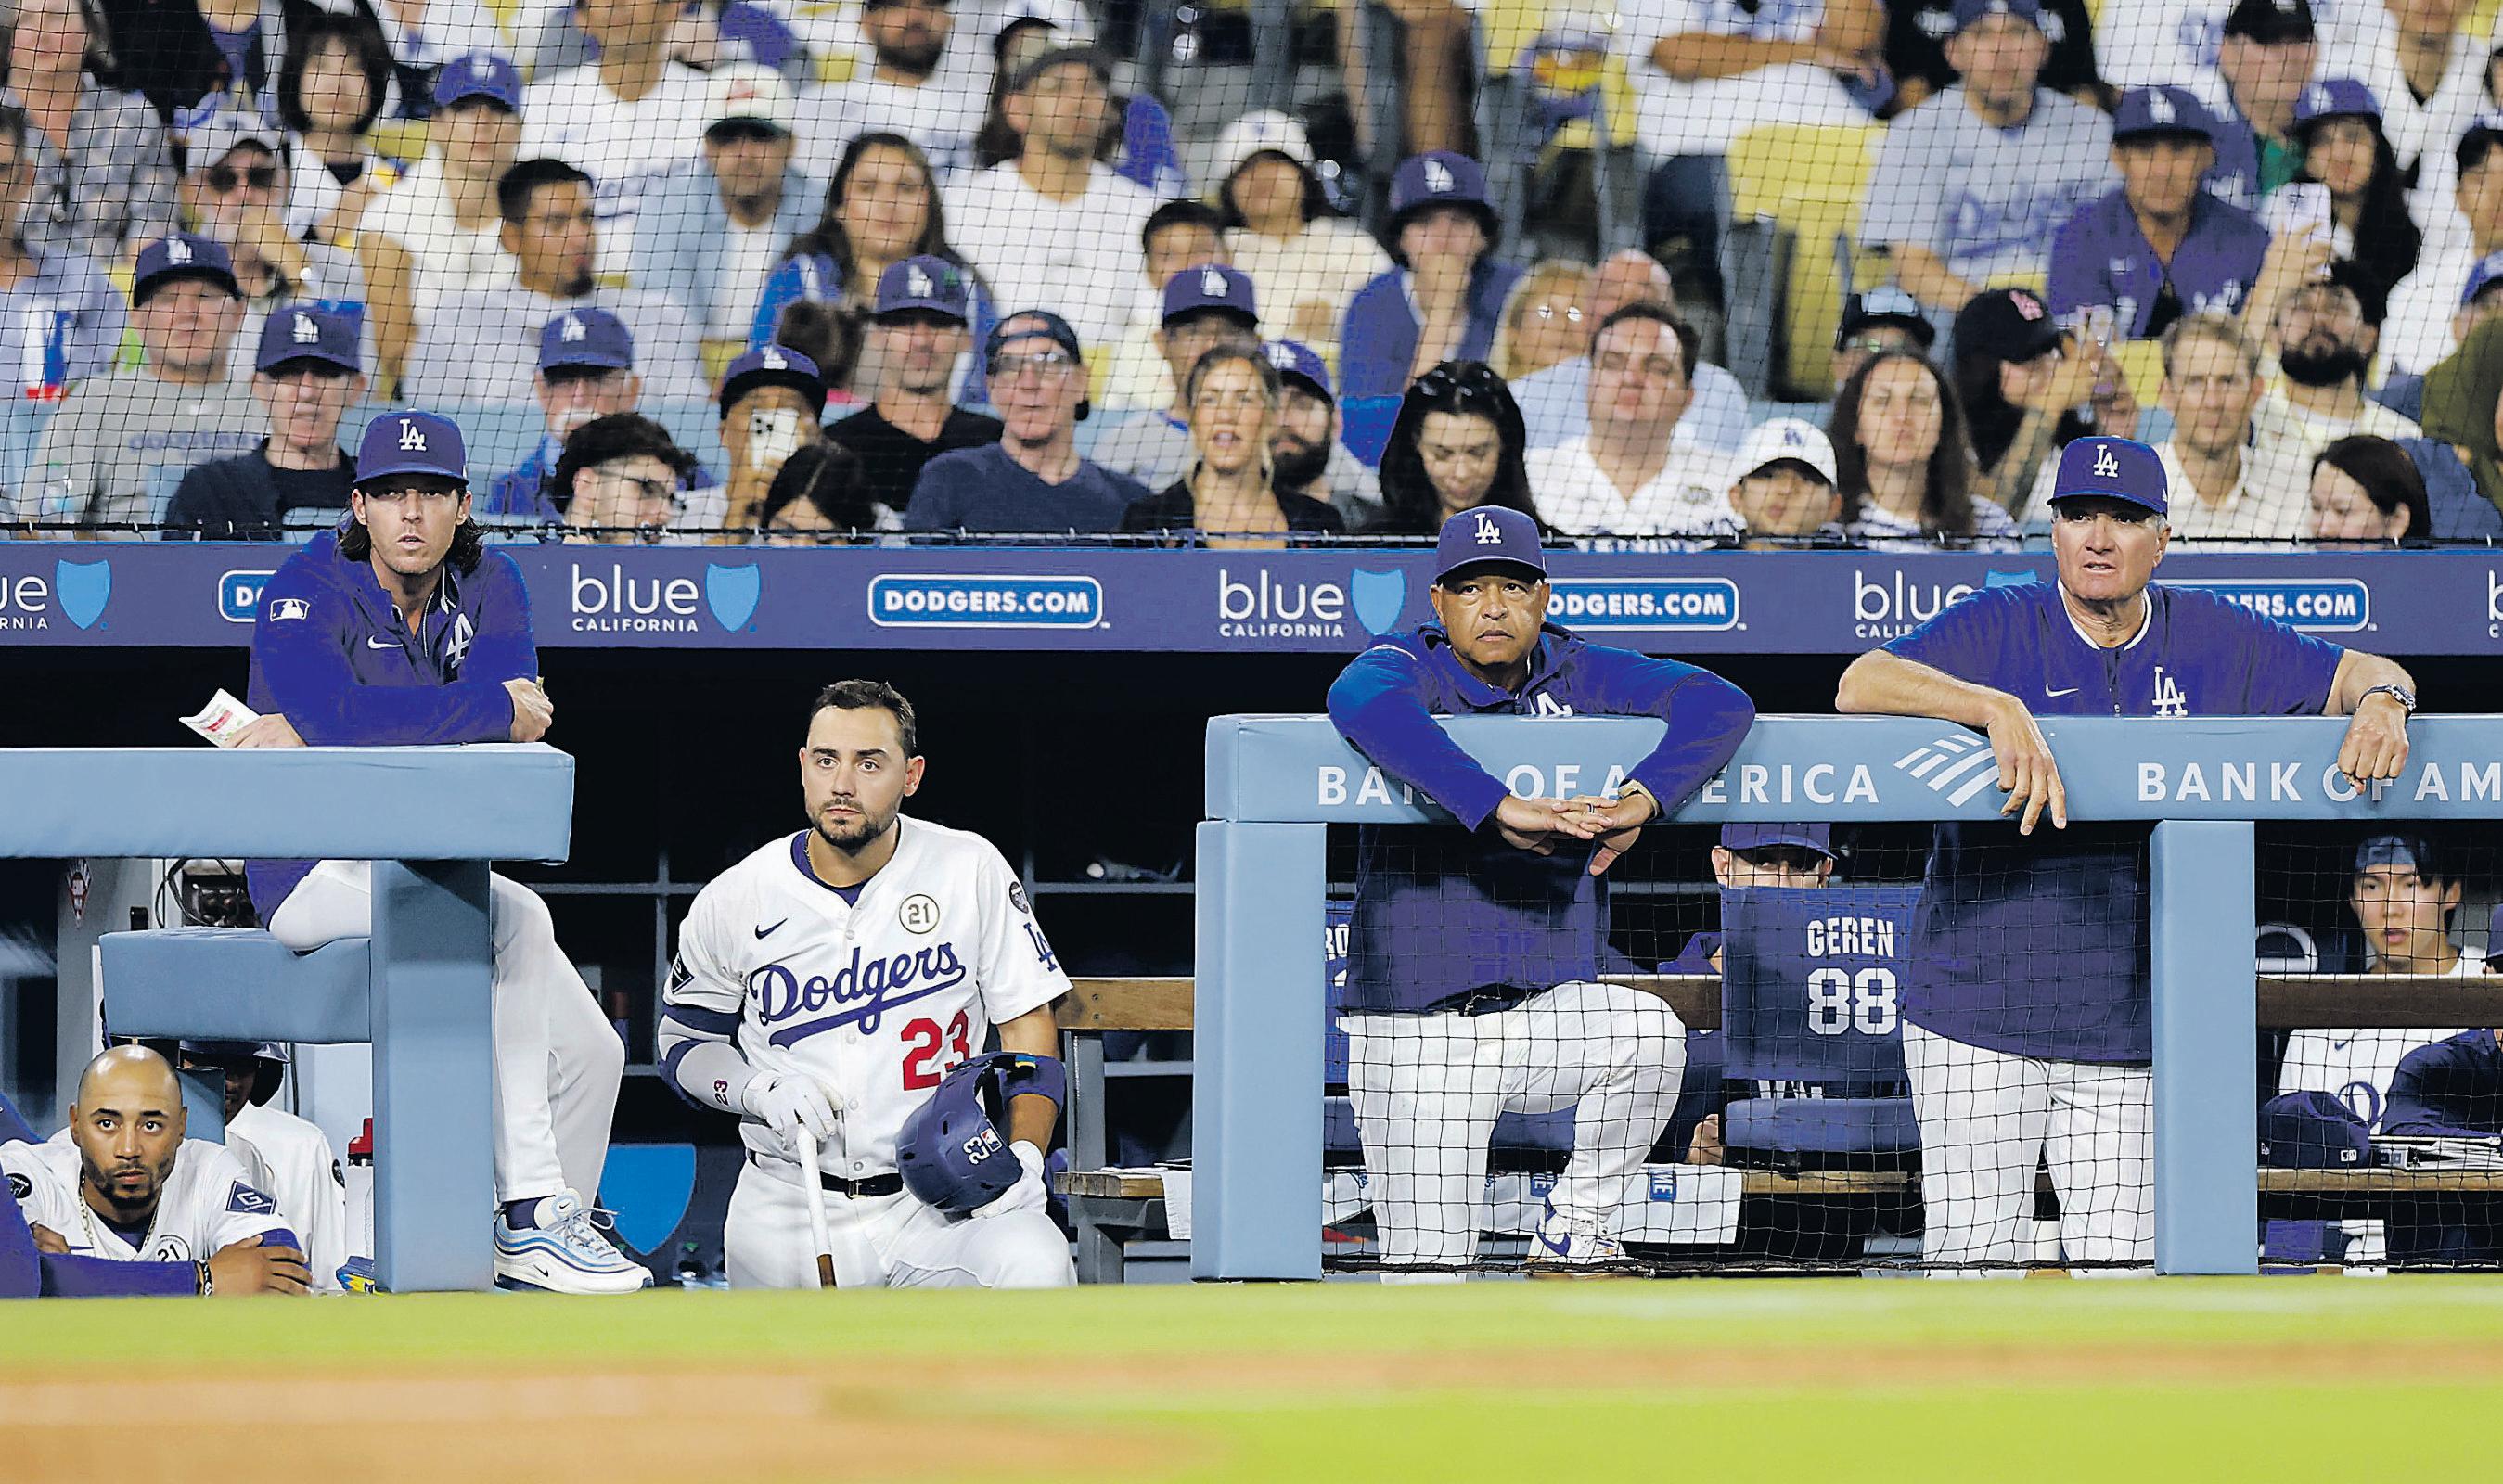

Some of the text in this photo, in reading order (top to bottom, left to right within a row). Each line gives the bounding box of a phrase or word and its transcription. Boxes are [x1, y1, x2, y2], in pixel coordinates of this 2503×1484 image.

[398, 418, 427, 451] LA
[2093, 444, 2119, 478] LA
[1474, 513, 1502, 544] LA
[571, 563, 699, 615] blue
[884, 590, 1090, 613] DODGERS.COM
[1219, 569, 1344, 620] blue
[571, 618, 699, 632] CALIFORNIA
[1219, 623, 1344, 638] CALIFORNIA
[2151, 666, 2188, 716] LA
[2137, 761, 2303, 802] BANK
[908, 903, 930, 925] 21
[1806, 916, 1894, 958] GEREN
[749, 941, 966, 1050] Dodgers
[1807, 967, 1897, 1035] 88
[900, 1008, 970, 1092] 23
[713, 1079, 730, 1106] 23
[963, 1136, 991, 1165] 23
